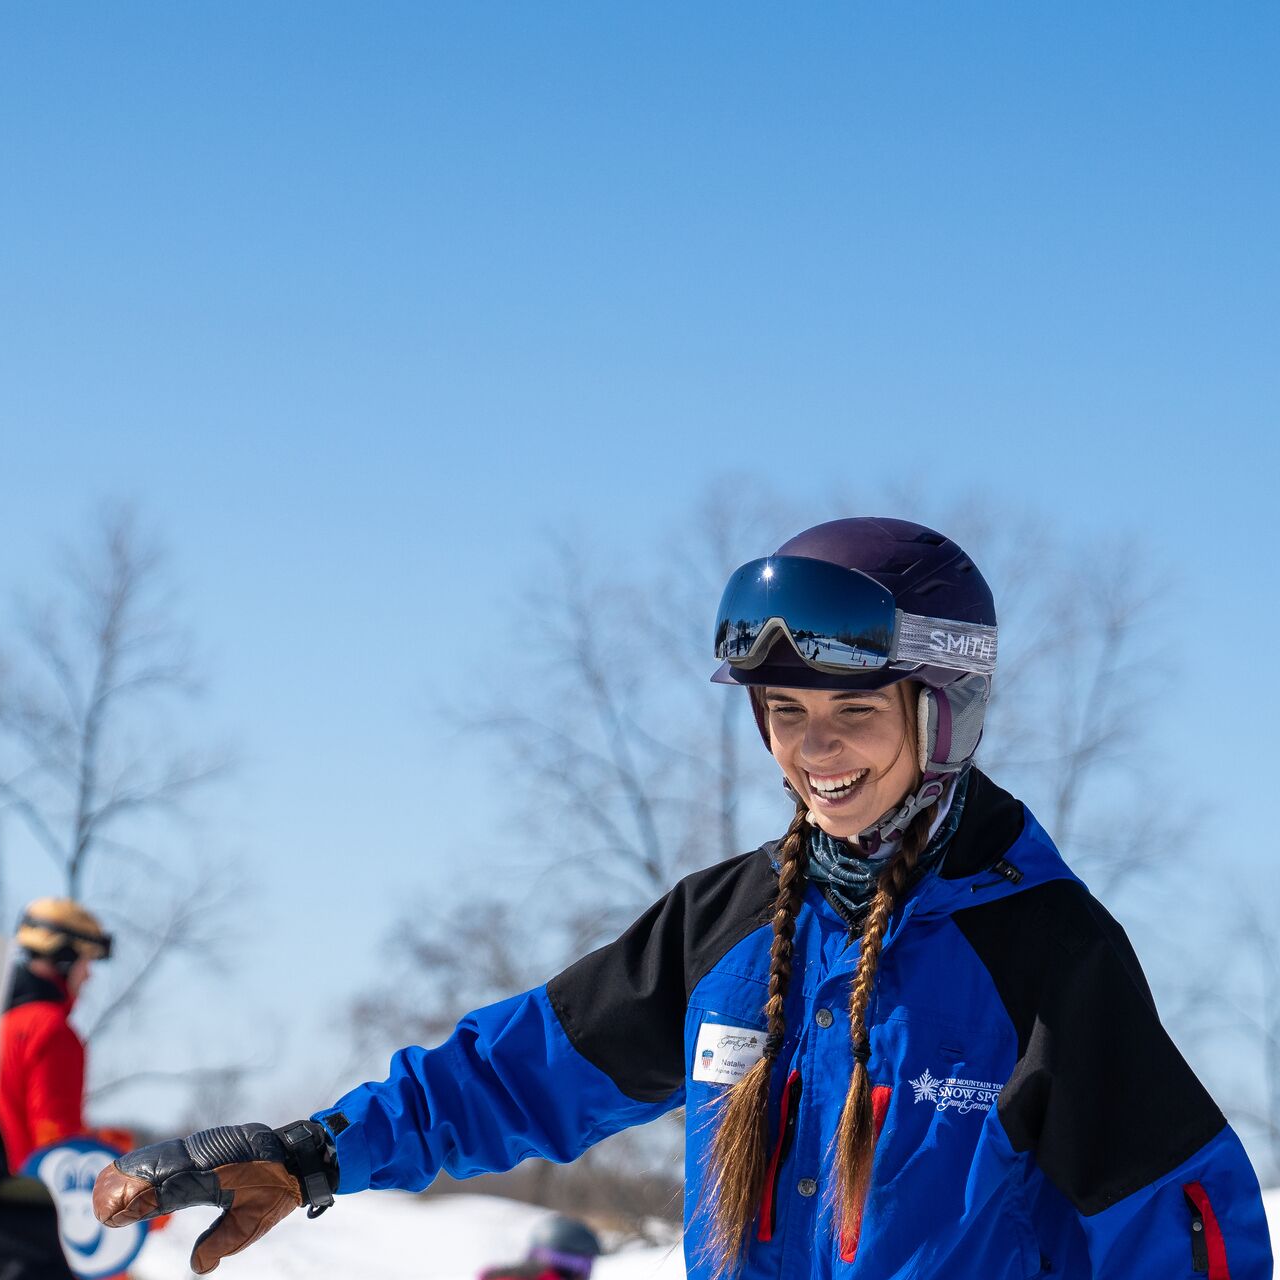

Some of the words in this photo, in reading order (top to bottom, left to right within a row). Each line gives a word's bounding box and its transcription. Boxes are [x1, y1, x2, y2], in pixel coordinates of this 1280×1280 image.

[930, 631, 992, 659] SMITH
[722, 1058, 746, 1069] Natalie
[957, 1078, 992, 1089] MOUNTAIN
[938, 1086, 976, 1100] SNOW
[976, 1090, 1000, 1102] SPO
